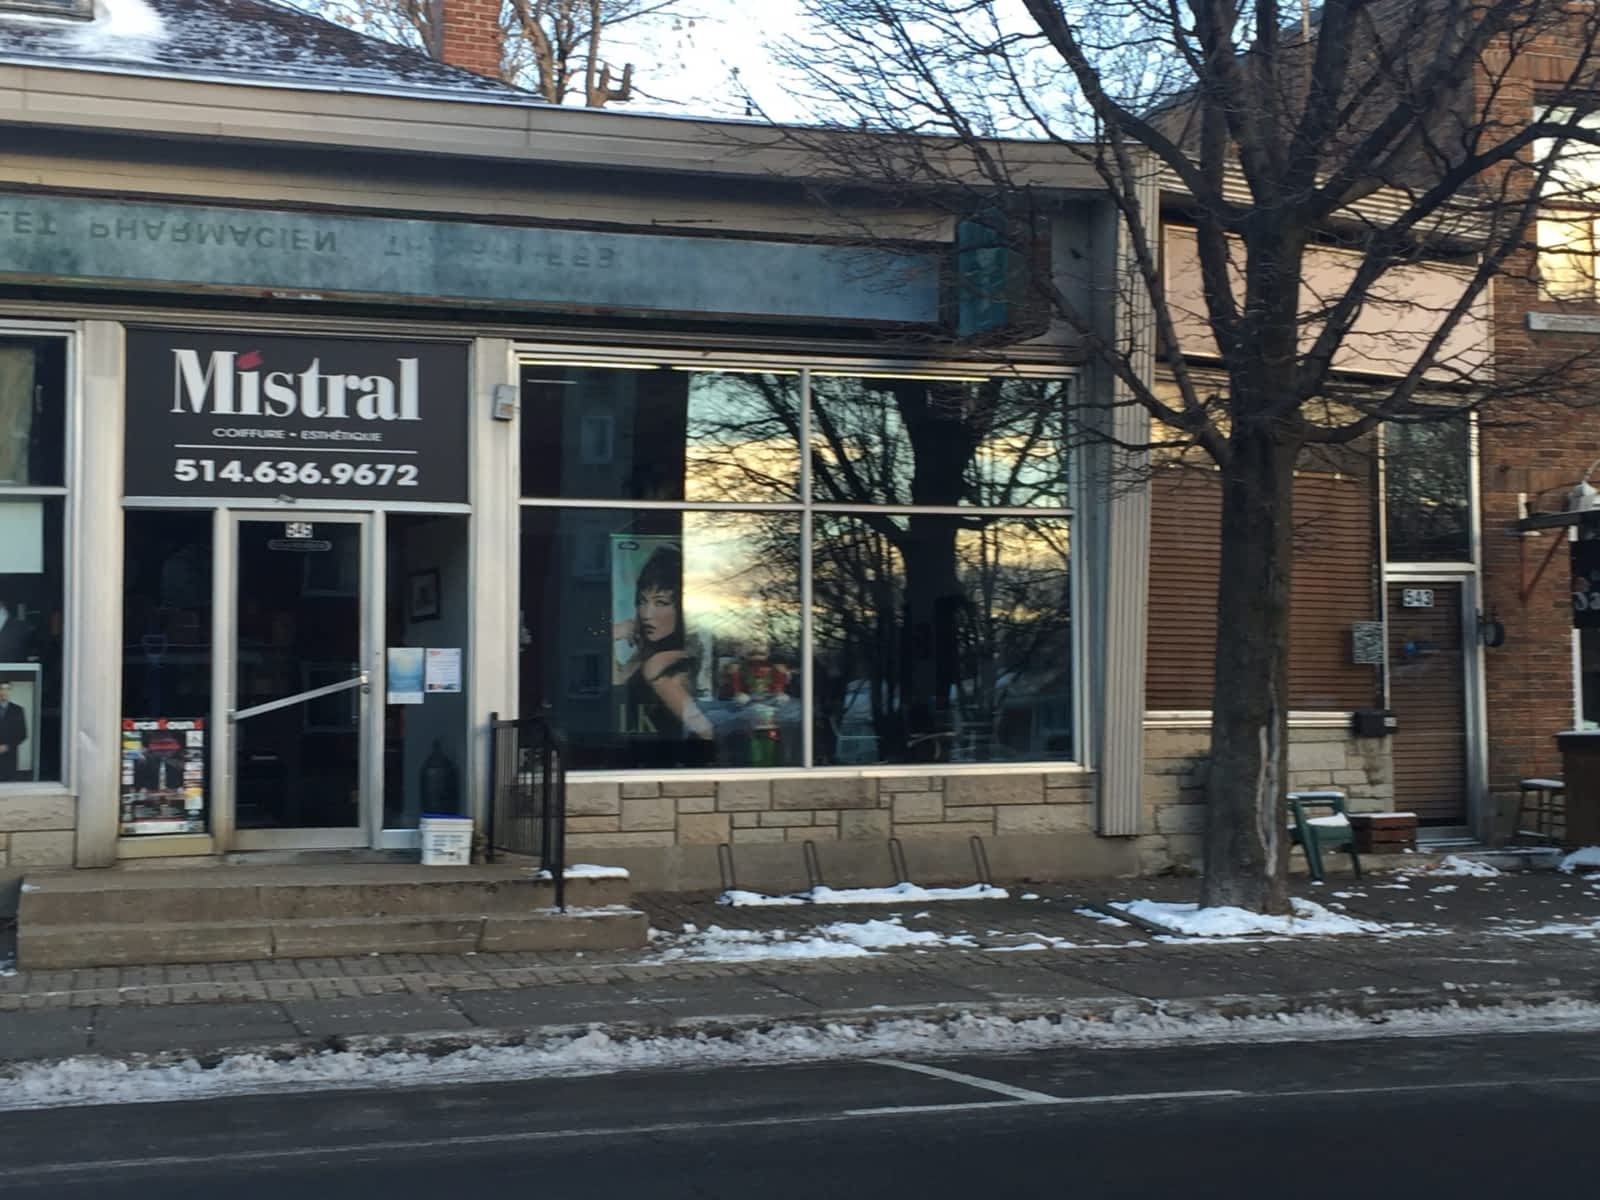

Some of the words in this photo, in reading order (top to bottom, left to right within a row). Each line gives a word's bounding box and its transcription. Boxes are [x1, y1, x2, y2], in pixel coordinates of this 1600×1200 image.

[170, 348, 422, 421] Mistral
[212, 427, 286, 439] COIFFURE
[300, 429, 383, 442] ESTHÉTIQUE
[174, 458, 419, 486] 514.636.9672
[1404, 590, 1433, 605] 543
